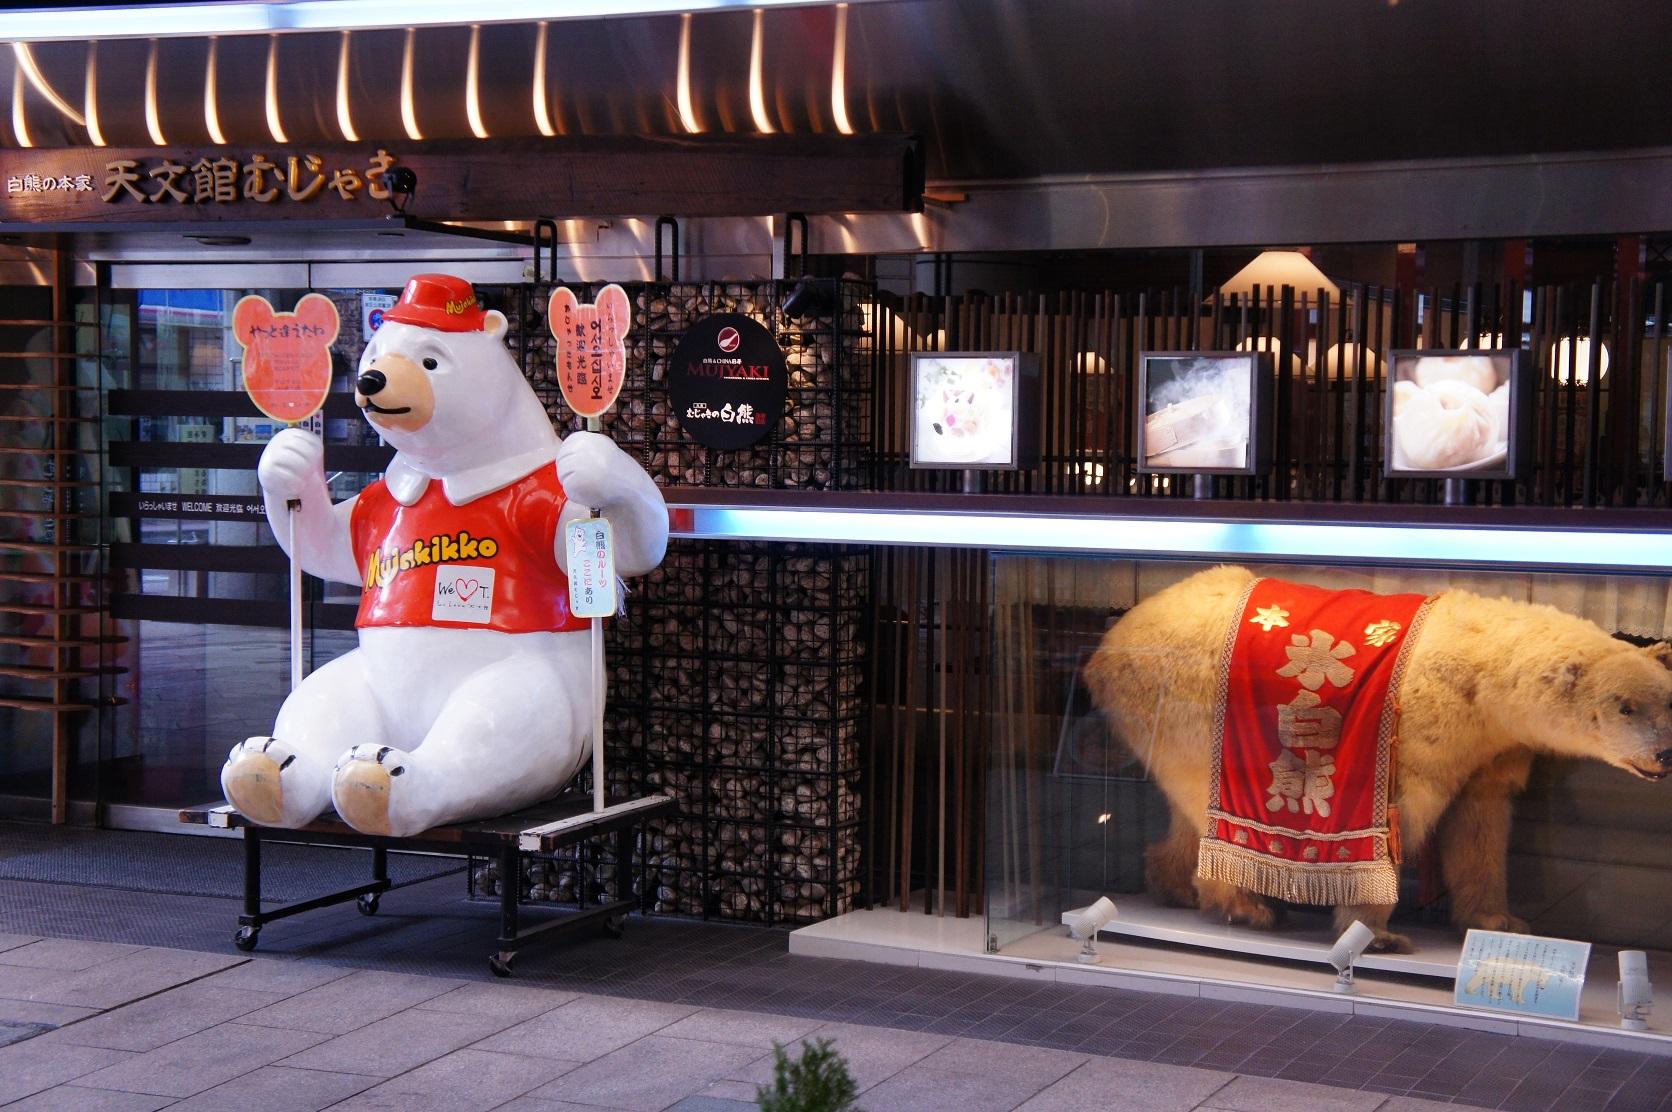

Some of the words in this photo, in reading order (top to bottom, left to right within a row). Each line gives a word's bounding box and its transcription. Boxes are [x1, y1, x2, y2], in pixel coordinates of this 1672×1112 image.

[7, 173, 95, 193] 白熊の本家
[101, 149, 394, 203] 天文館むじゃき
[138, 501, 177, 511] いらっしゃいませ
[182, 502, 213, 512] WELCOME
[365, 530, 499, 593] Mujakikko
[583, 559, 593, 605] ここにあり
[595, 531, 608, 588] 白熊のルーツ
[438, 582, 456, 595] We
[1265, 628, 1358, 818] 氷白熊
